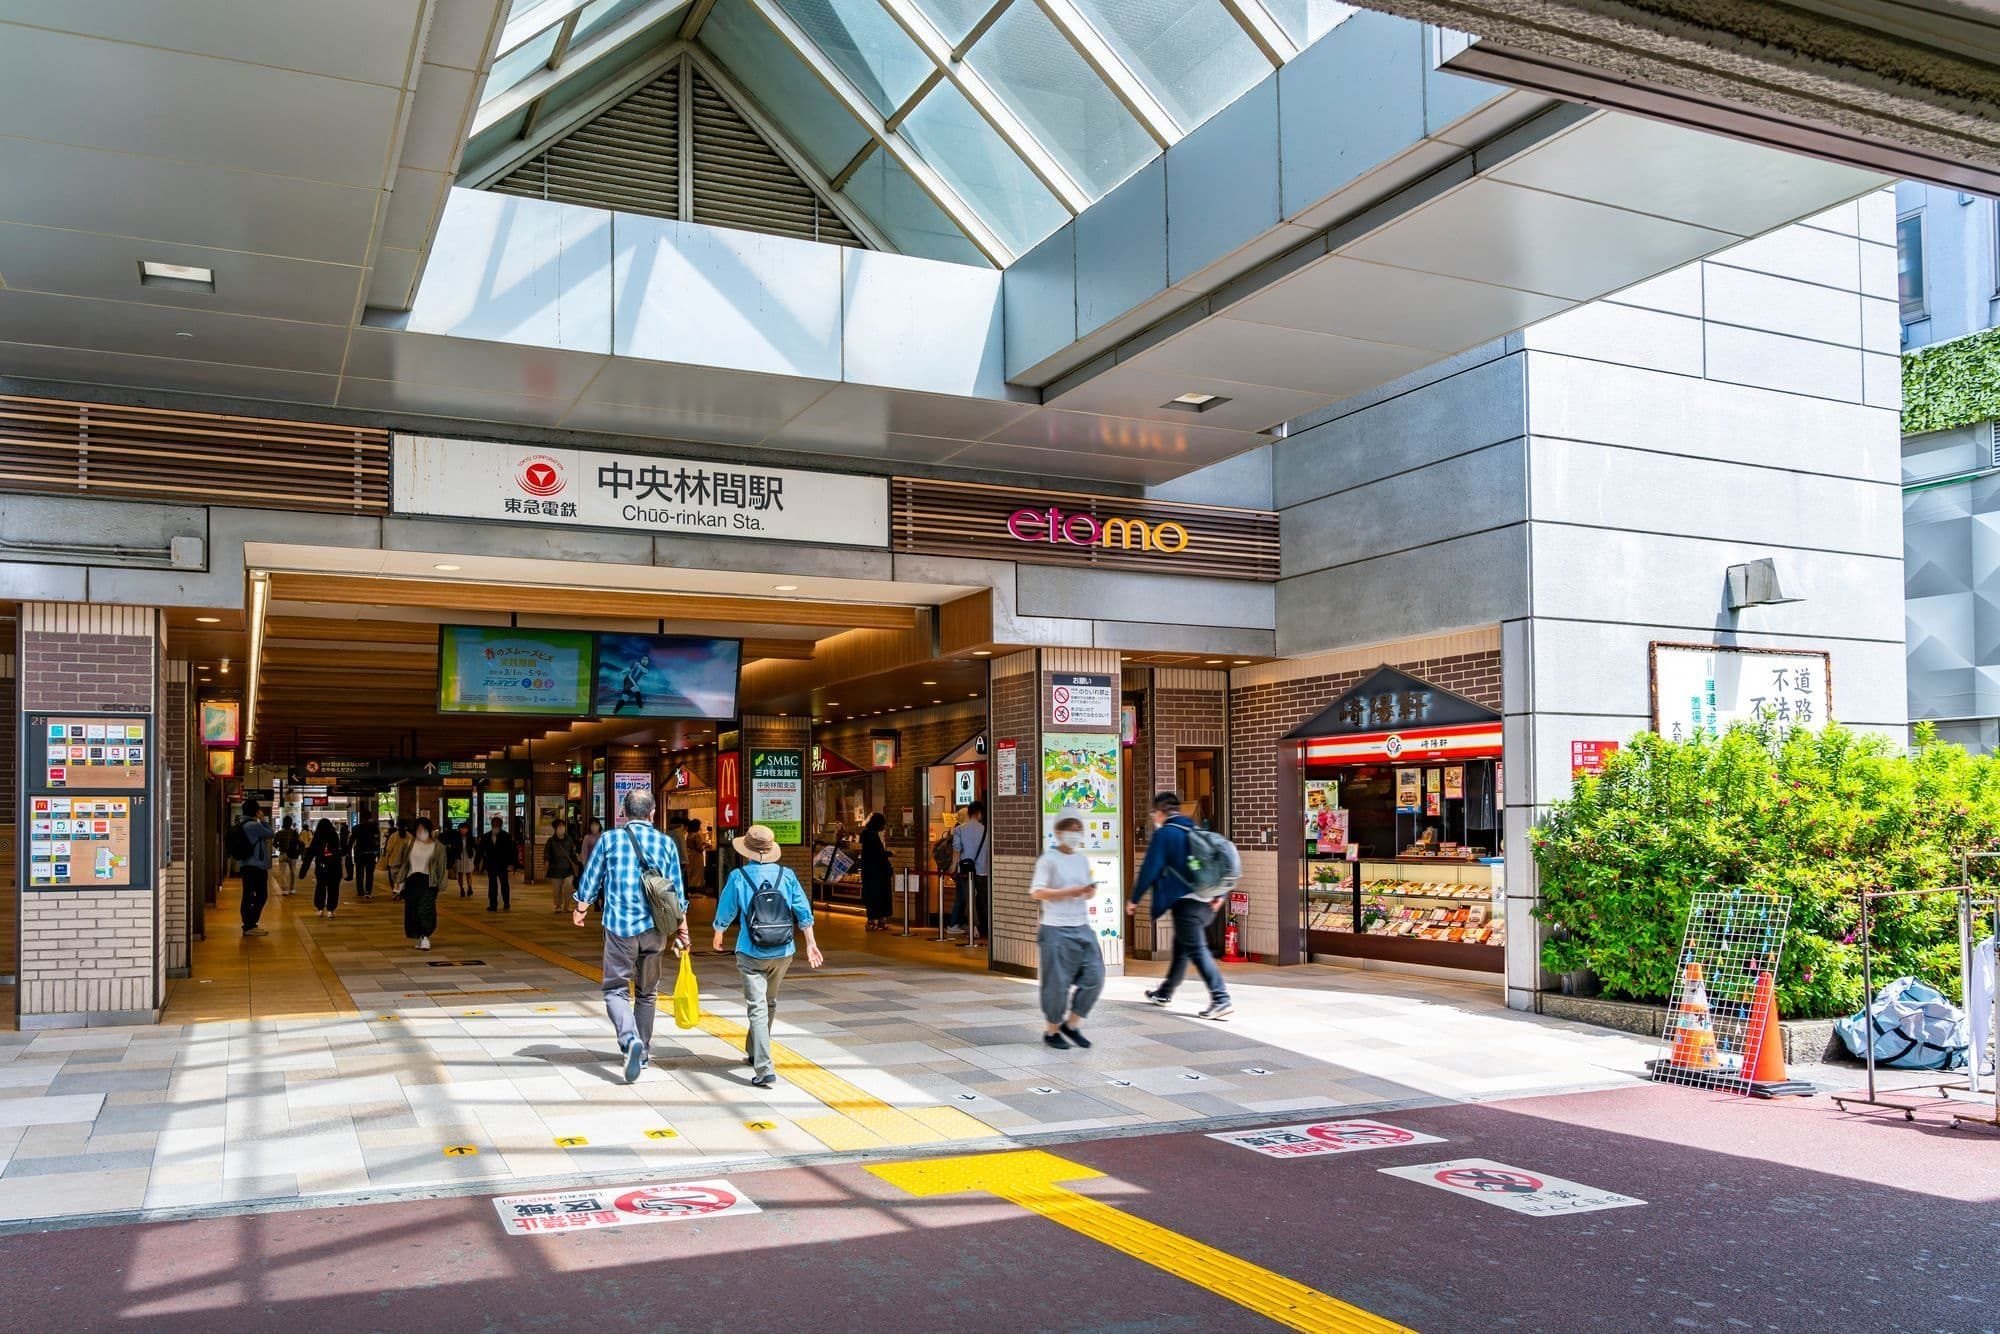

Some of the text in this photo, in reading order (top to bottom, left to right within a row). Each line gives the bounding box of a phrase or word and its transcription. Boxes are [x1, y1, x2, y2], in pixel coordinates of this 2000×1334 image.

[517, 454, 564, 471] TOKYU CORPORATION
[598, 461, 784, 511] 中央林間駅
[503, 498, 578, 518] 東急電鉄
[622, 504, 765, 531] Chūō-rinkan Sta.
[1007, 506, 1189, 553] etomo
[1072, 677, 1092, 685] お願い
[1794, 667, 1815, 723] 道路
[31, 717, 47, 726] 2F
[767, 755, 799, 766] SMBC
[755, 769, 798, 777] 三井住友銀行
[133, 797, 145, 805] 1F
[514, 1198, 603, 1217] 区域
[1519, 1195, 1627, 1212] 歩きスマホ
[512, 1210, 620, 1231] 重点禁止
